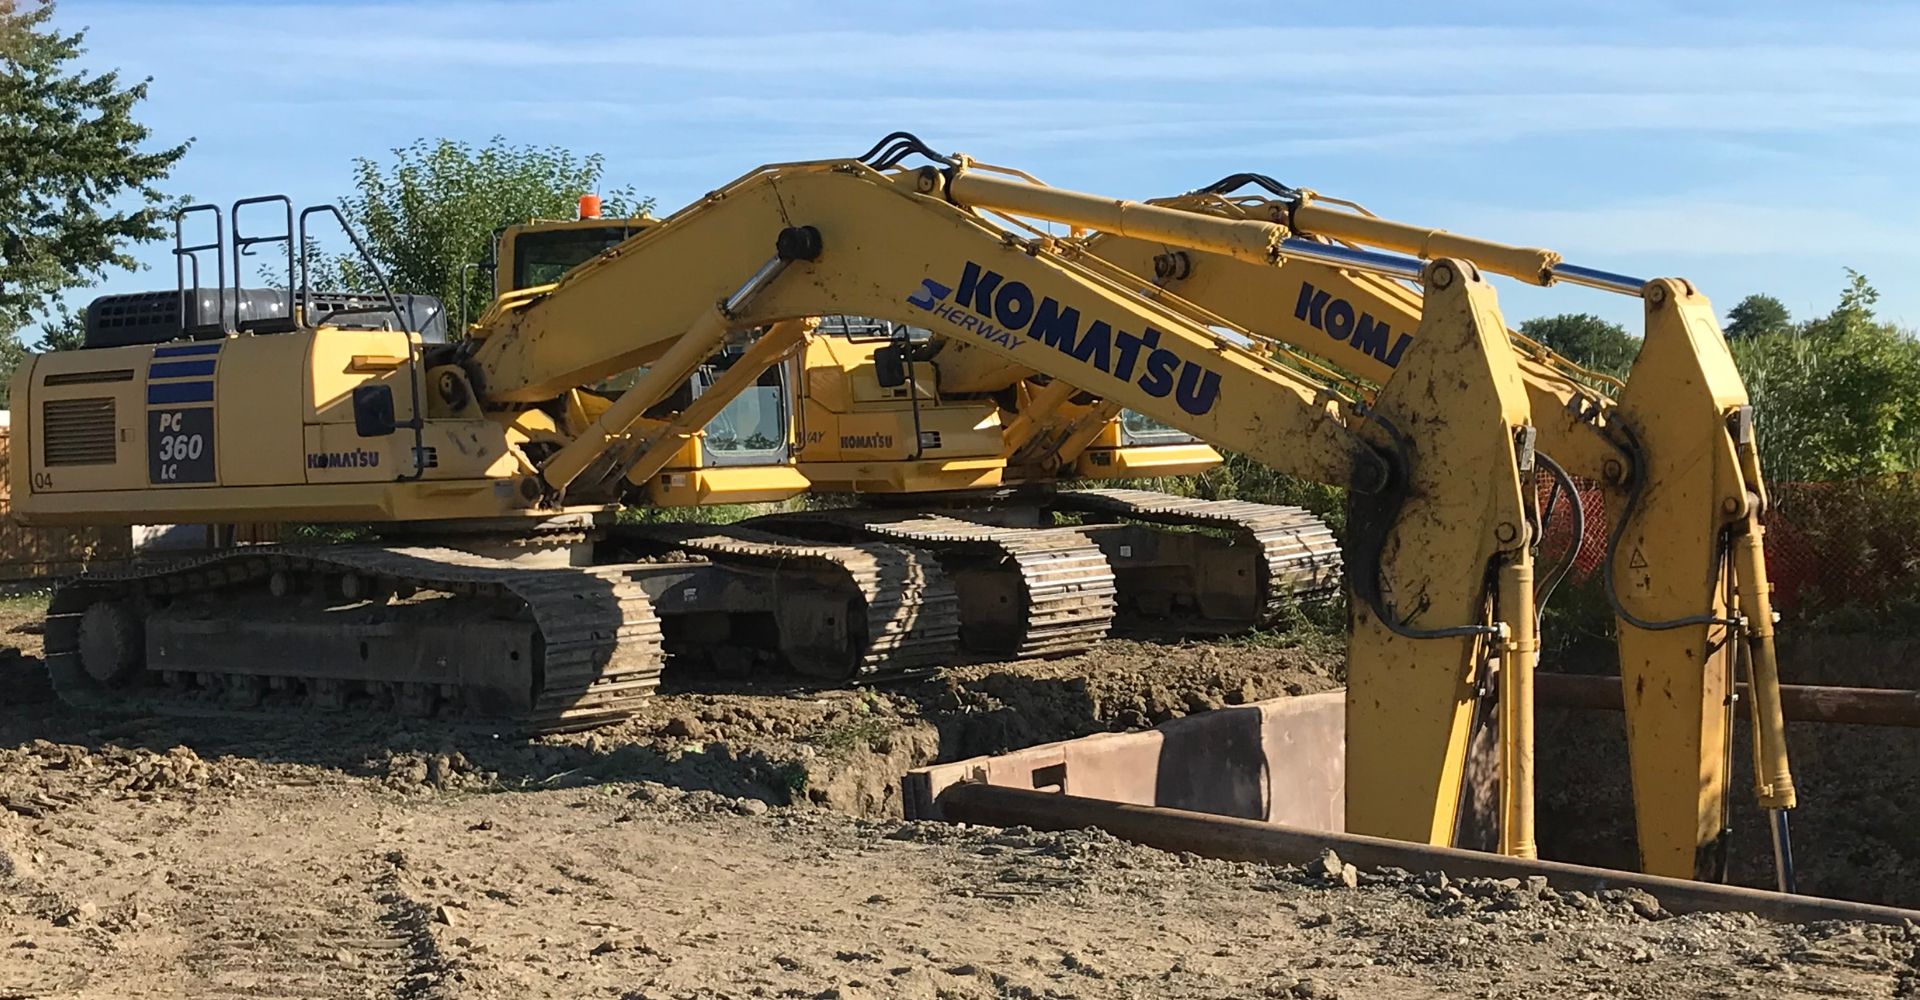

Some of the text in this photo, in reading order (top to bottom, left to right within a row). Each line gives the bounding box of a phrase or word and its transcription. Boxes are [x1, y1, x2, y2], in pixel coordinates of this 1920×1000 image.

[955, 260, 1222, 416] KOMATSU
[159, 412, 183, 433] PC
[159, 434, 203, 461] 360
[840, 432, 893, 449] KOMATSU
[307, 448, 380, 469] KOMATSU
[34, 472, 53, 489] 04
[160, 463, 178, 480] LC
